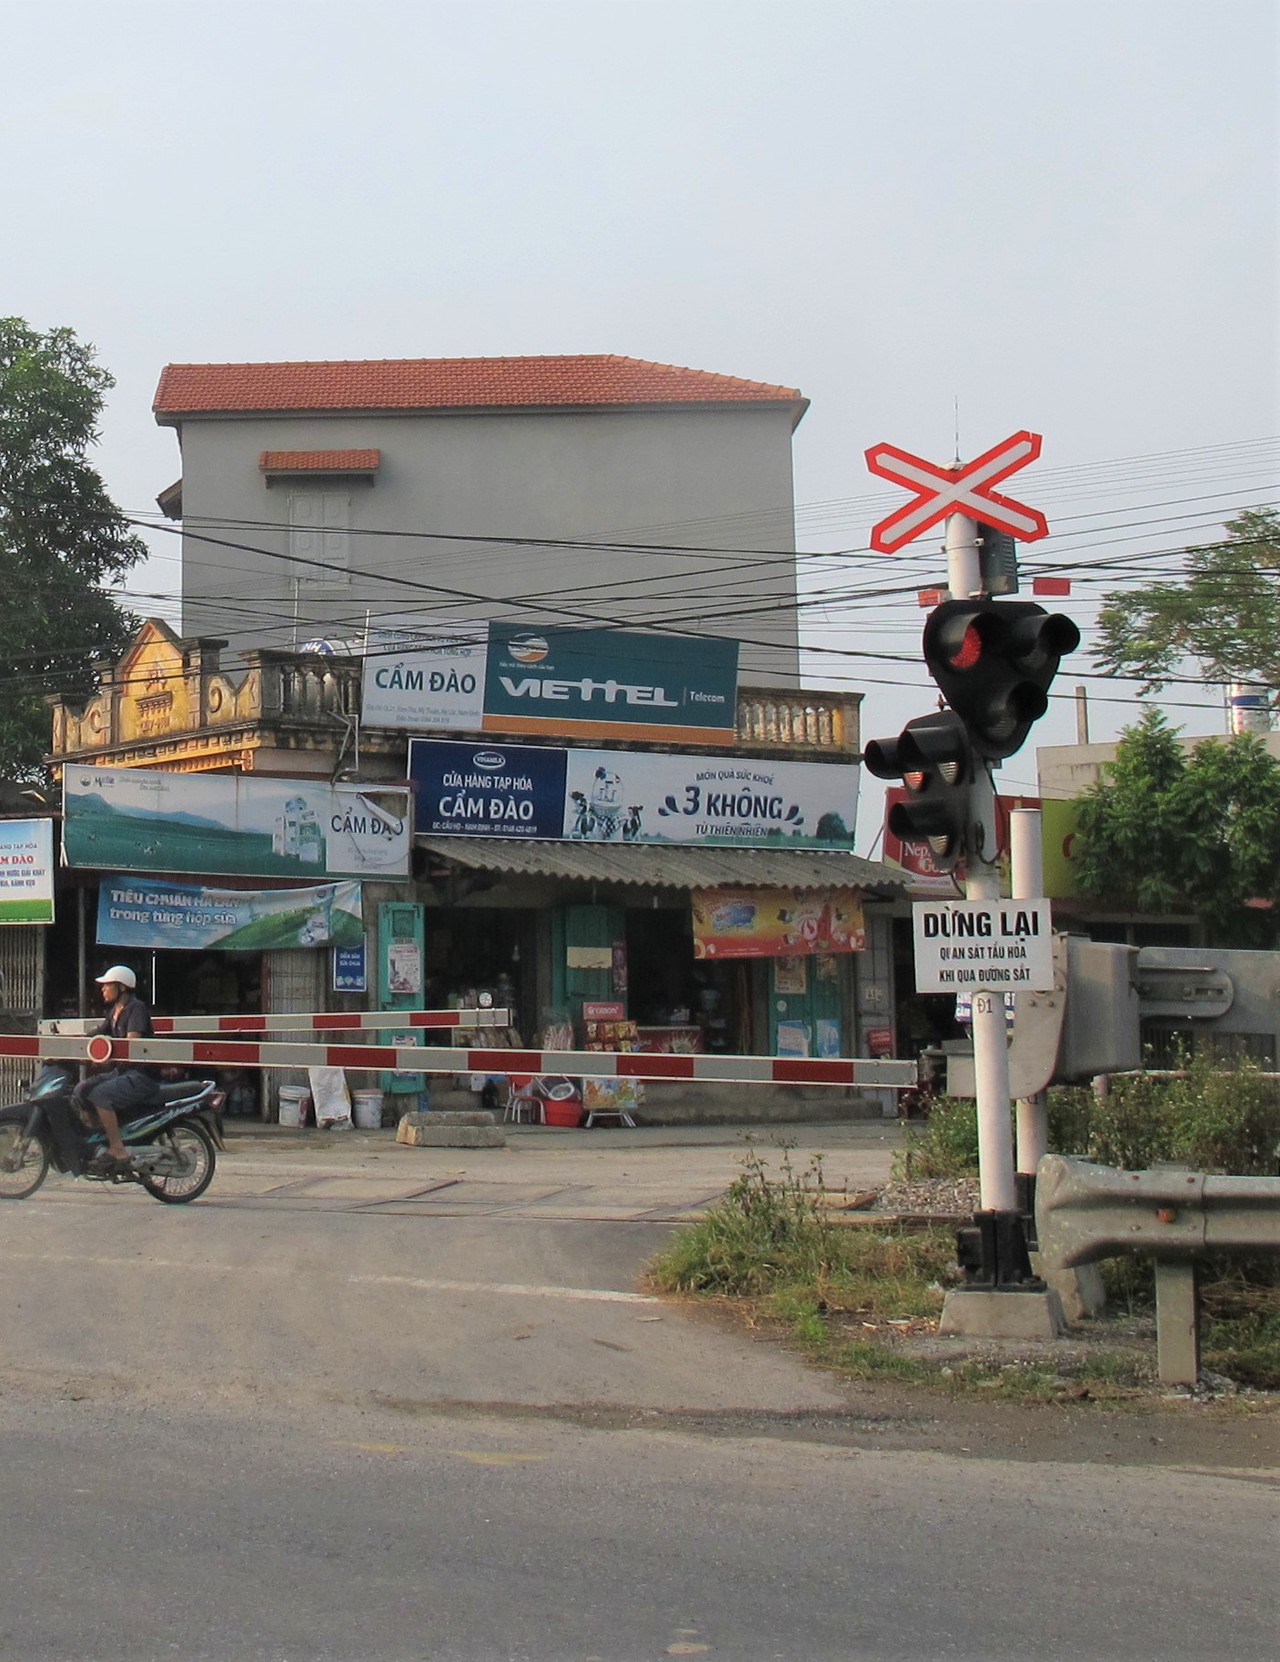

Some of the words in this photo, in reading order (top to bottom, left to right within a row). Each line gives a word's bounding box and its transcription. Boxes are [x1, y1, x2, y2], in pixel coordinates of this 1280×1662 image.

[375, 662, 424, 691] CẨM
[428, 668, 476, 694] ĐÀO
[499, 676, 678, 707] VIETTEL
[690, 691, 725, 703] Telecom
[443, 771, 463, 787] CỬA
[464, 773, 492, 789] HÀNG
[493, 776, 512, 792] TẠP
[513, 775, 533, 790] HÓA
[439, 789, 484, 818] CẨM
[488, 795, 534, 821] ĐÀO
[683, 786, 700, 816] 3
[706, 787, 783, 819] KHÔNG
[331, 807, 367, 833] CẨM
[12, 854, 35, 864] ĐÀO
[110, 908, 150, 923] trong
[152, 908, 184, 925] từng
[186, 910, 211, 926] hộp
[213, 911, 237, 925] sữa
[923, 906, 992, 938] DỪNG
[1000, 911, 1039, 942] LẠI
[968, 944, 985, 959] SÁT
[939, 969, 955, 982] KHI
[957, 968, 976, 983] QUA
[978, 965, 1011, 982] ĐƯỜNG
[977, 998, 993, 1014] Đ1
